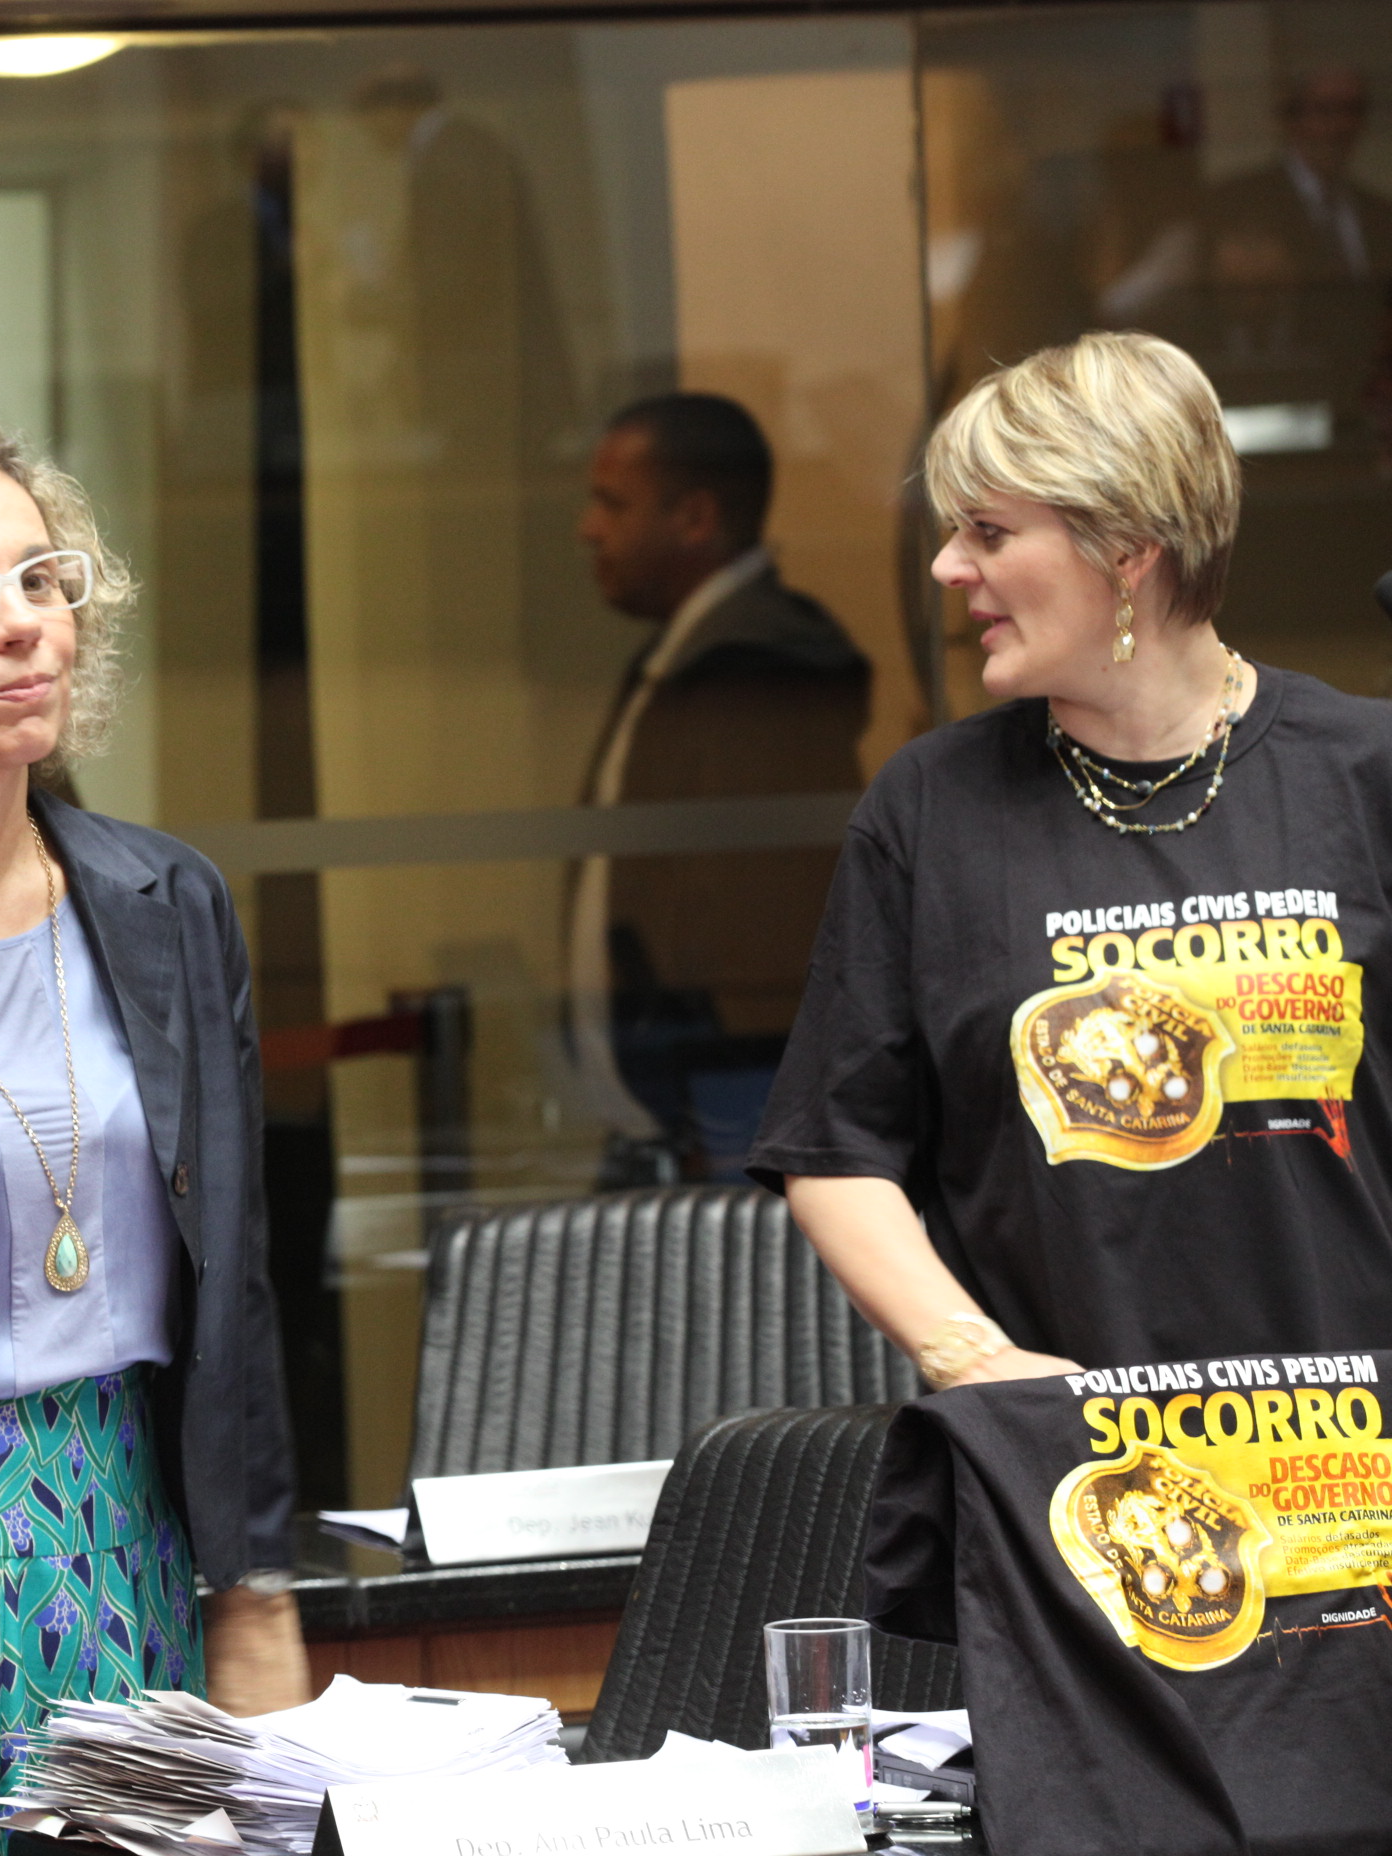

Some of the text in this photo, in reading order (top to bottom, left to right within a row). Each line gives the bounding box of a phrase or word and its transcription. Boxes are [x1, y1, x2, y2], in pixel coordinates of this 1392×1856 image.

[1046, 889, 1339, 937] POLICIAIS CIVIS PEDEM
[1051, 917, 1344, 982] SOCORRO
[1235, 972, 1345, 999] DESCASO
[1216, 997, 1345, 1023] DO GOVERNO
[1242, 1024, 1255, 1035] DE
[1066, 1088, 1116, 1124] SANTA
[1121, 1112, 1191, 1130] CATARINA
[1065, 1355, 1378, 1395] POLICIAIS CIVIS PEDEM
[1082, 1387, 1383, 1454] SOCORRO
[1269, 1452, 1391, 1485] DESCASO
[1154, 1477, 1221, 1531] CIVIL
[1249, 1481, 1392, 1513] DO GOVERNO
[569, 1512, 619, 1534] Jean
[1277, 1515, 1294, 1526] DE
[1297, 1512, 1337, 1525] SANTA
[1083, 1495, 1111, 1544] ESTADO
[1159, 1608, 1232, 1627] CATARINA
[1282, 1544, 1340, 1556] Promoções
[1321, 1607, 1377, 1624] DIGNIDADE
[535, 1831, 588, 1853] Ana
[594, 1822, 675, 1849] Paula
[681, 1817, 754, 1842] Lima
